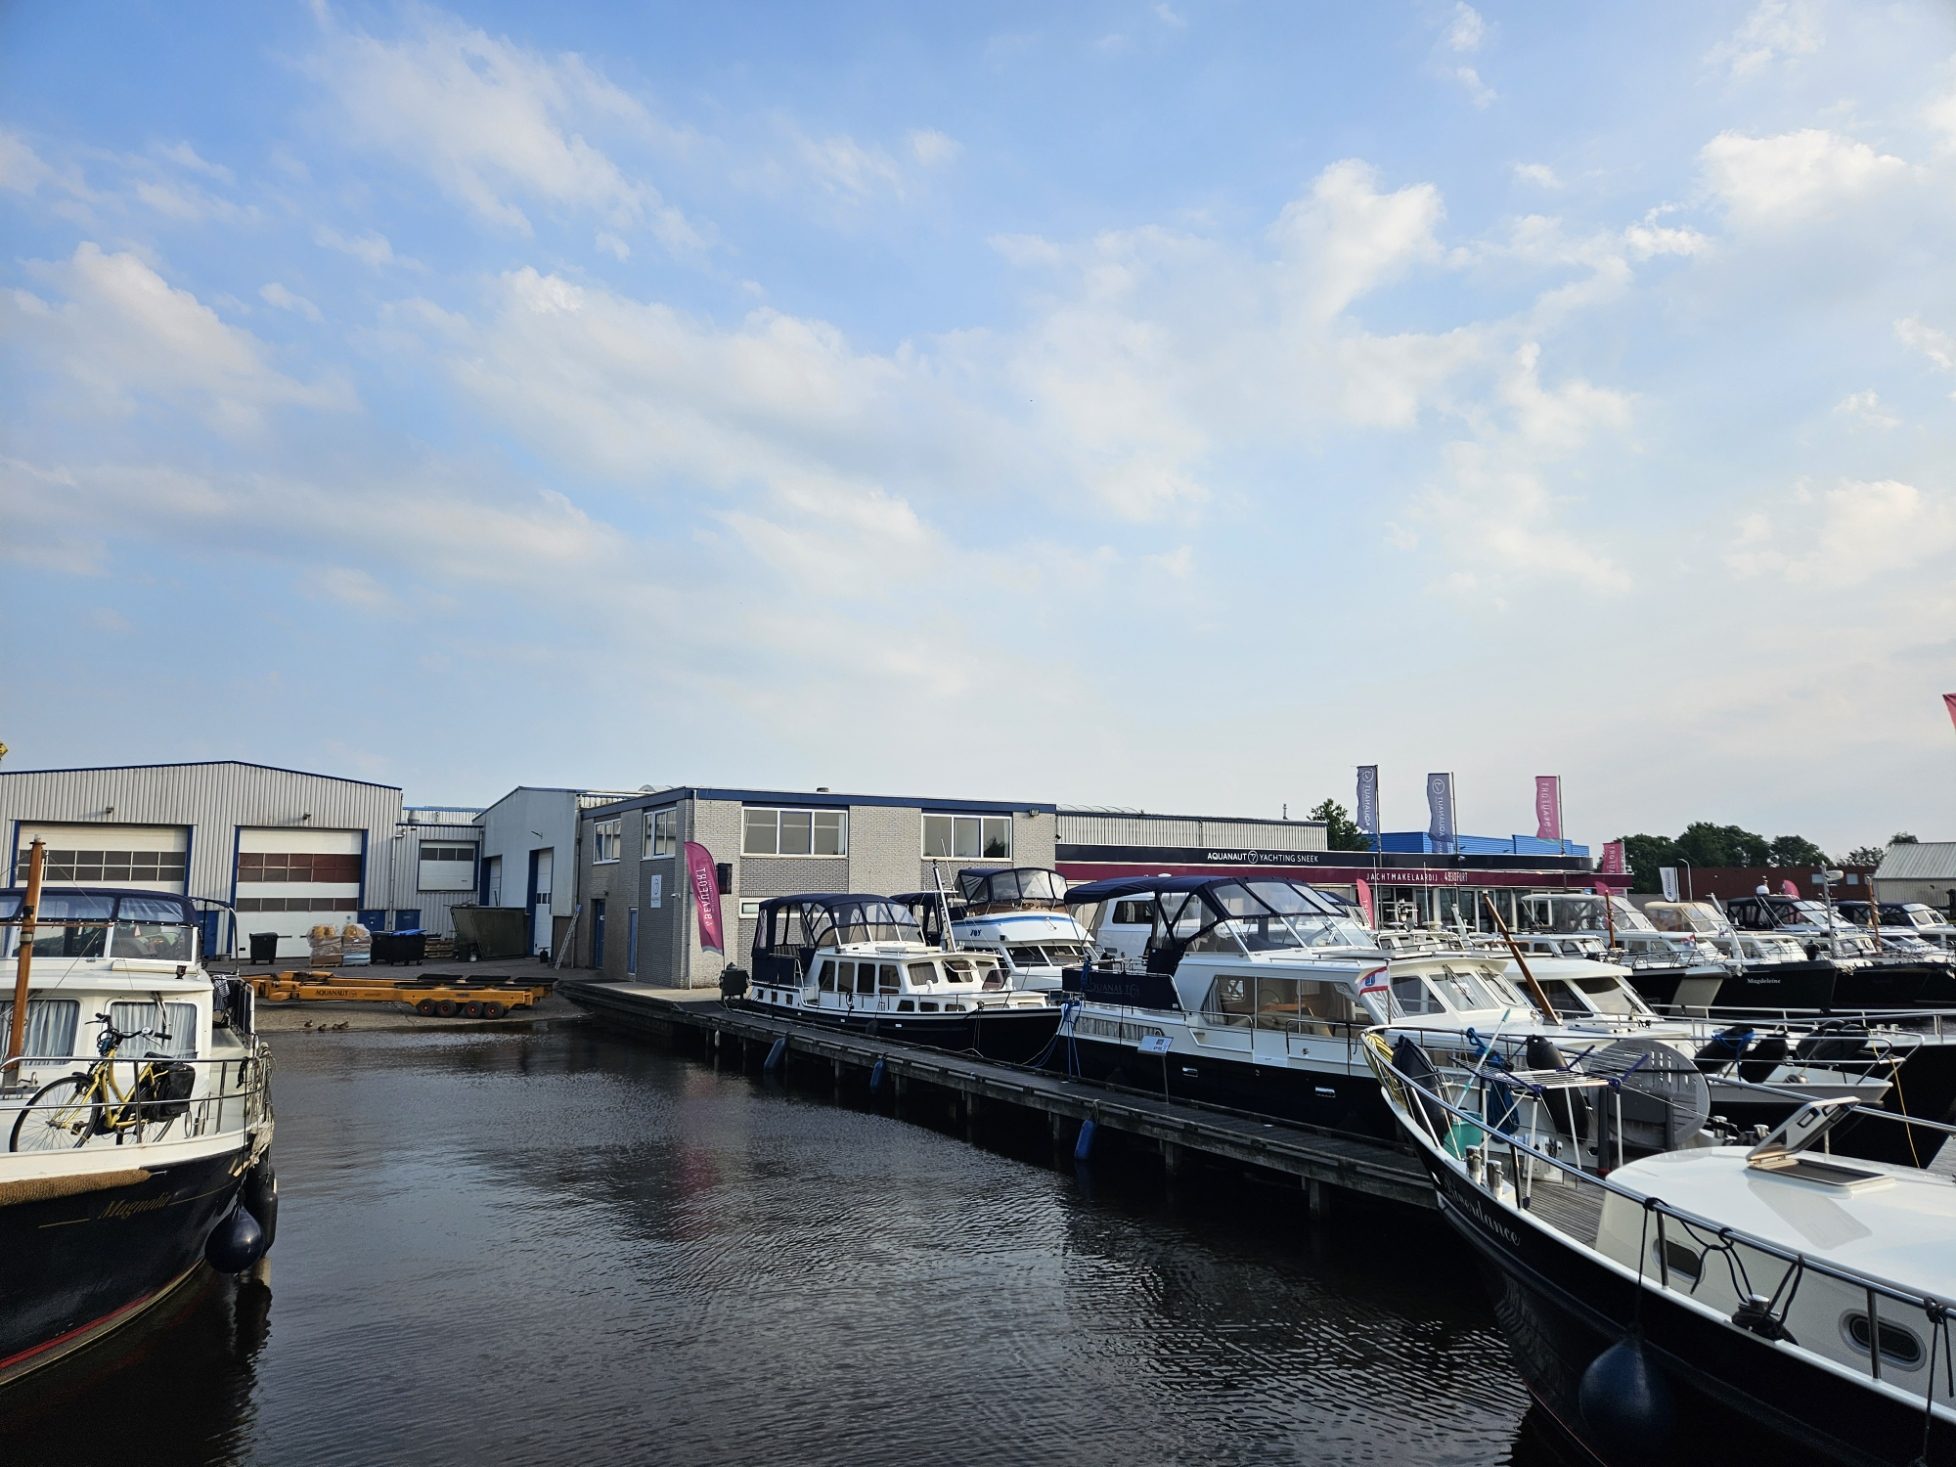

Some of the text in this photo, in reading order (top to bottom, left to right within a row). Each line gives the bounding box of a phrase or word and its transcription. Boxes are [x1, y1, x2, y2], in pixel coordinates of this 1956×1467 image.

[1207, 852, 1319, 863] AQUANAUT YACHTING SNEEK
[1366, 872, 1438, 882] JACHTMAKELAARDIJ
